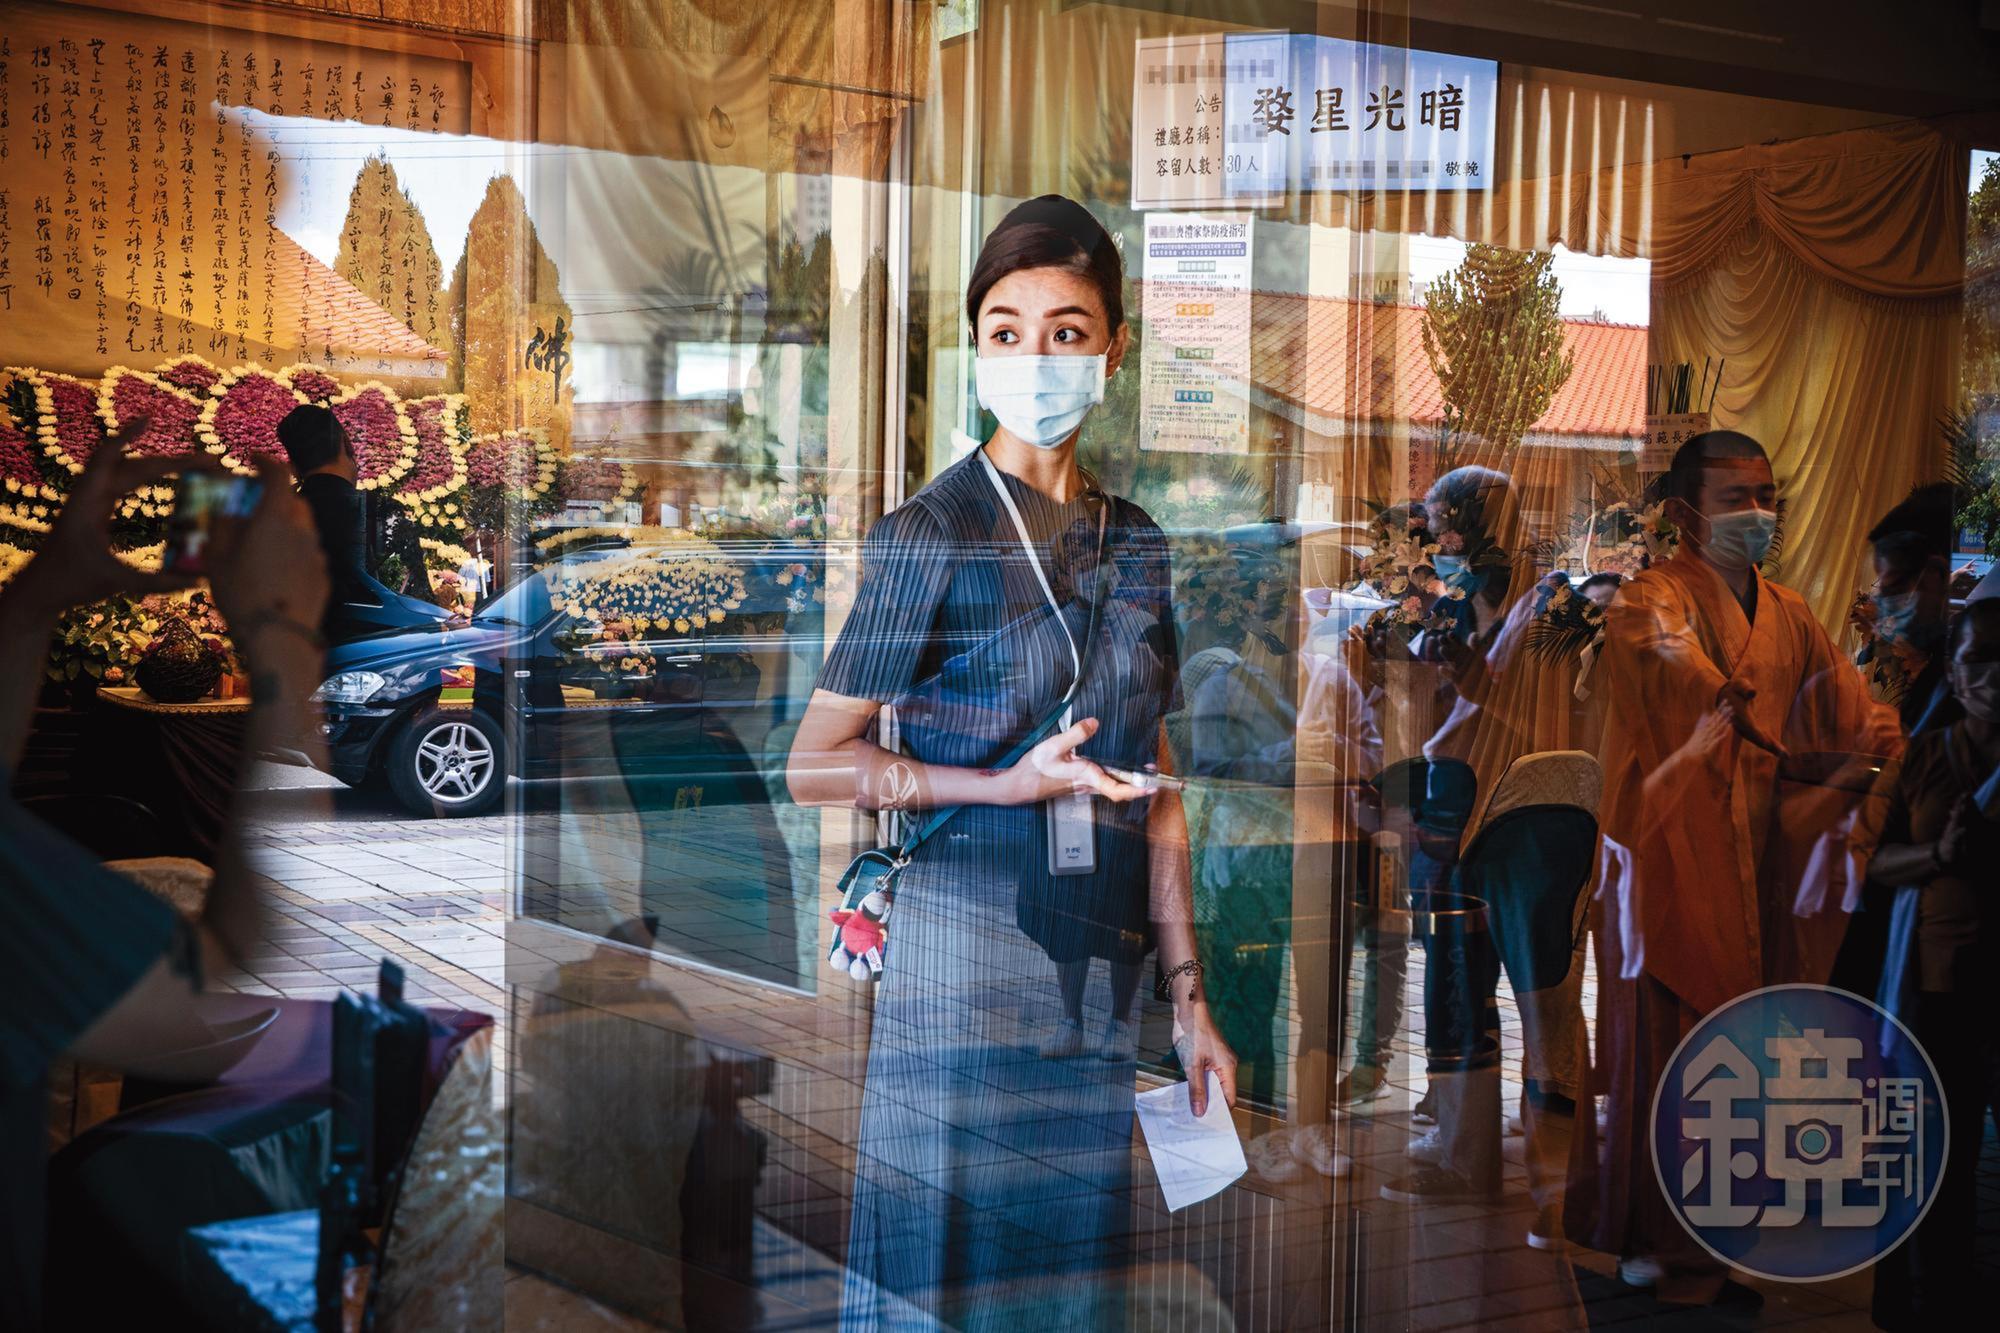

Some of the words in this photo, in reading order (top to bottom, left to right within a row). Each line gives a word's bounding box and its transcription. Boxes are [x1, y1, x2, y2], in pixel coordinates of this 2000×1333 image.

[1195, 93, 1222, 113] 公告
[1252, 83, 1465, 136] 婺星光暗
[1227, 154, 1241, 173] 30
[1246, 155, 1259, 172] 人
